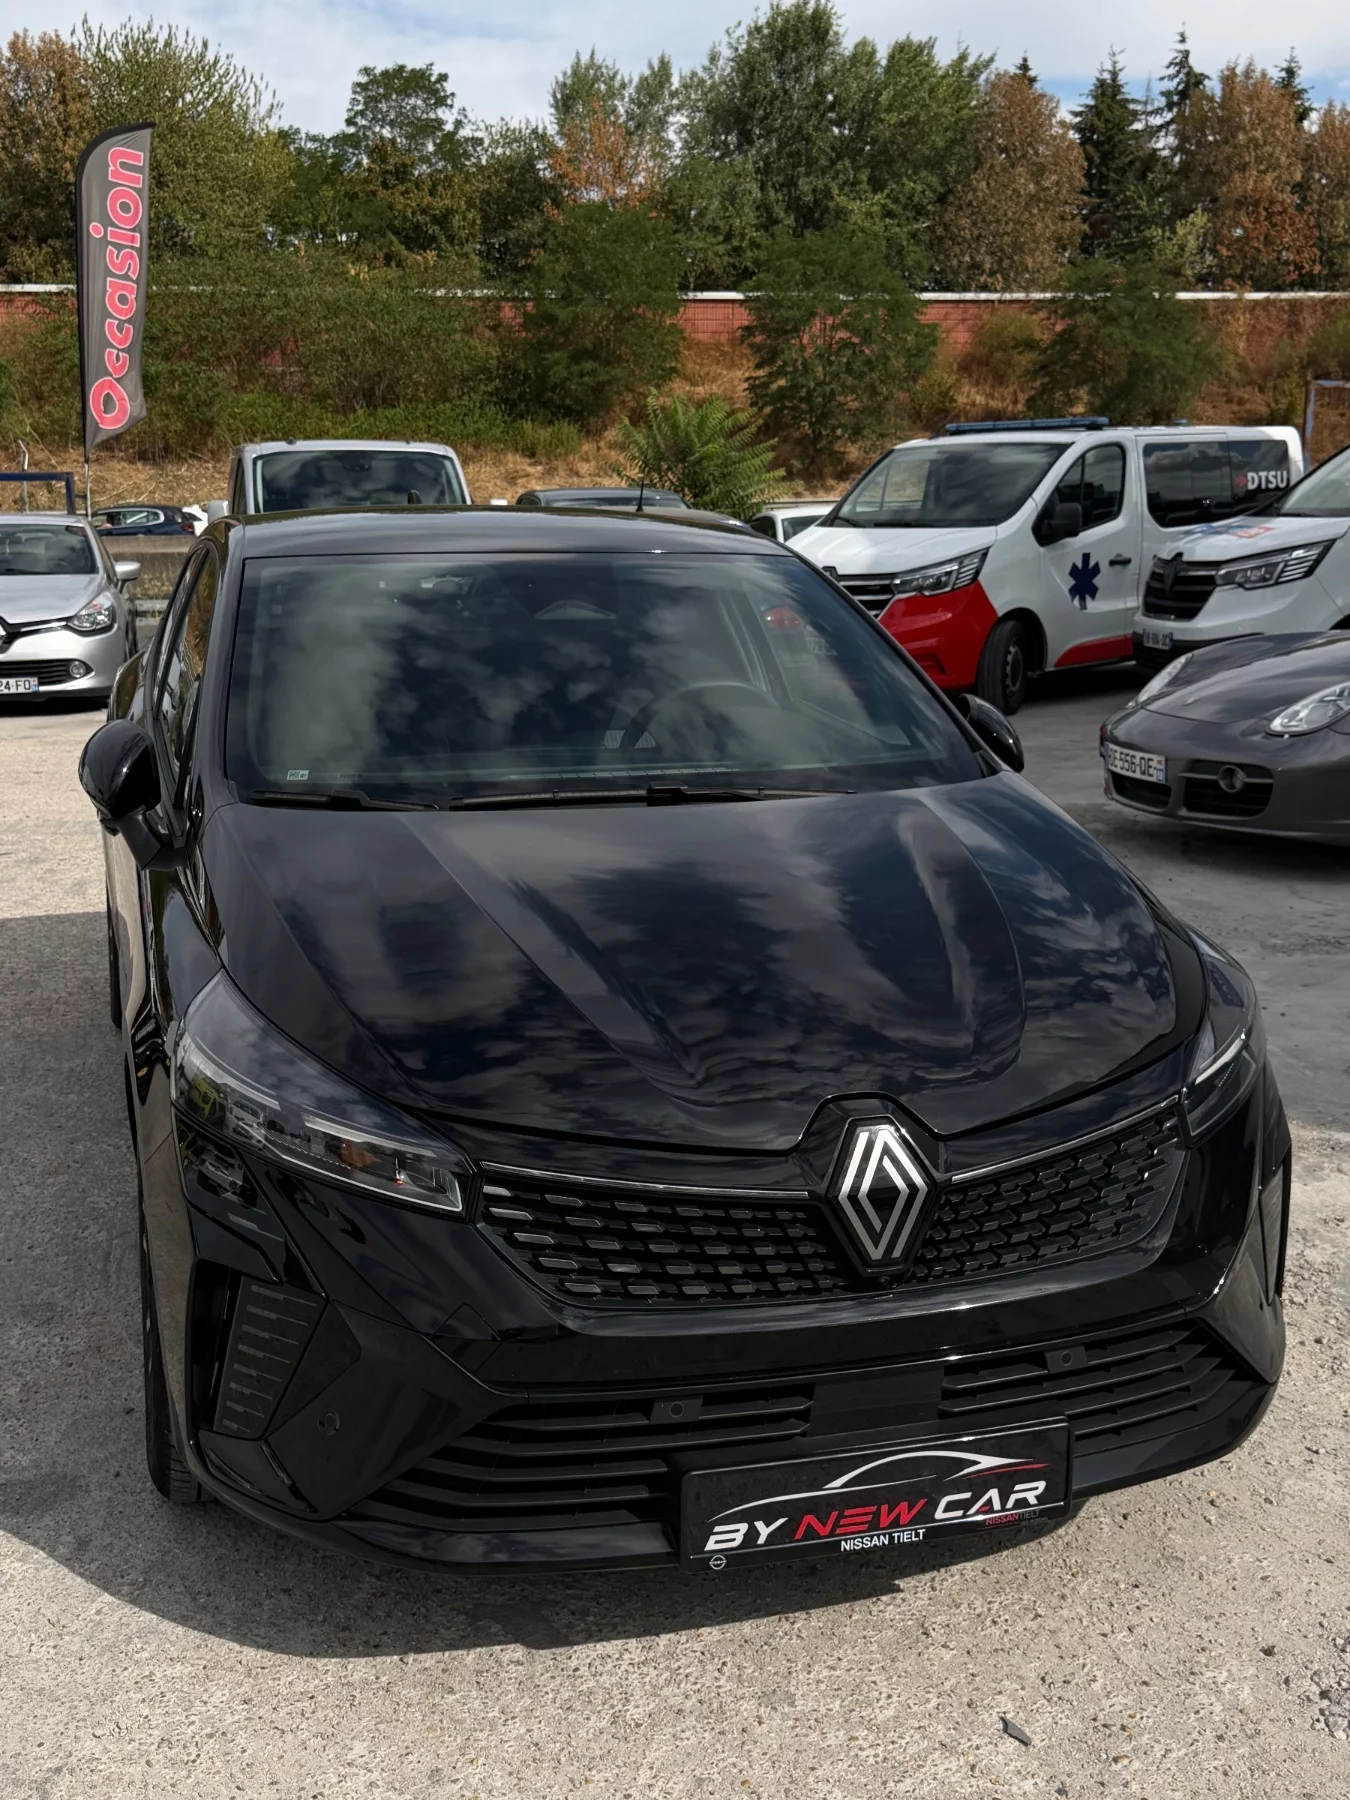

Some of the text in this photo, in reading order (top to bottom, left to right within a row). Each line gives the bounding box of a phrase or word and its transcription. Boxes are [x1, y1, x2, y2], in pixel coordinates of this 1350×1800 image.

[89, 146, 144, 430] Occasion
[1247, 470, 1288, 490] DTSU
[704, 1480, 1046, 1551] BY NEW CAR
[841, 1529, 926, 1552] NISSAN TIELT
